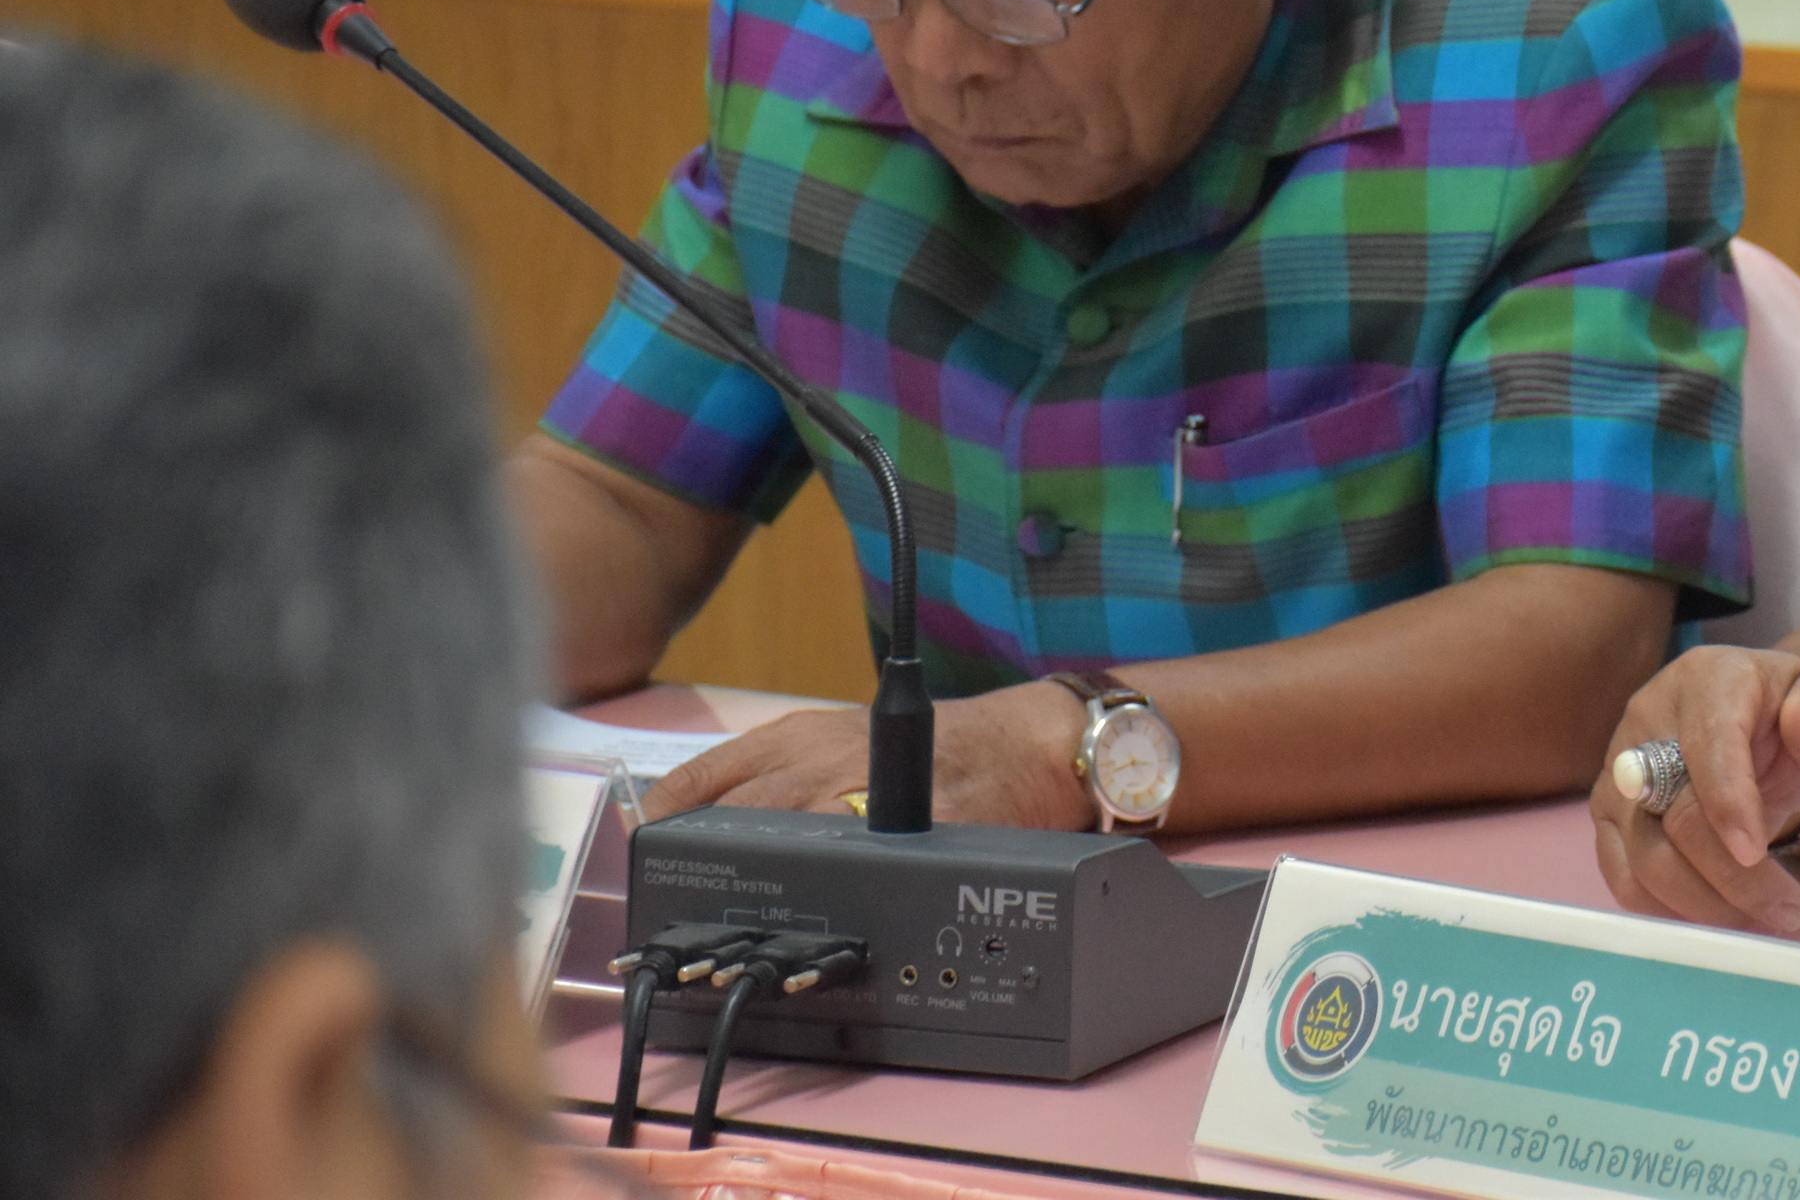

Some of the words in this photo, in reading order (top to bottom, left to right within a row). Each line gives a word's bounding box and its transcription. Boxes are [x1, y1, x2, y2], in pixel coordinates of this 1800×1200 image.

[644, 858, 738, 877] PROFESSIONAL
[644, 872, 728, 891] CONFERENCE
[733, 880, 783, 895] SYSTEM
[957, 884, 1058, 921] NPE
[761, 906, 793, 923] LINE
[957, 913, 1058, 932] RESEARCH
[896, 994, 920, 1007] REC
[927, 996, 968, 1011] PHONE
[969, 990, 1016, 1005] VOLUME
[1389, 980, 1622, 1077] นายสุดใจ
